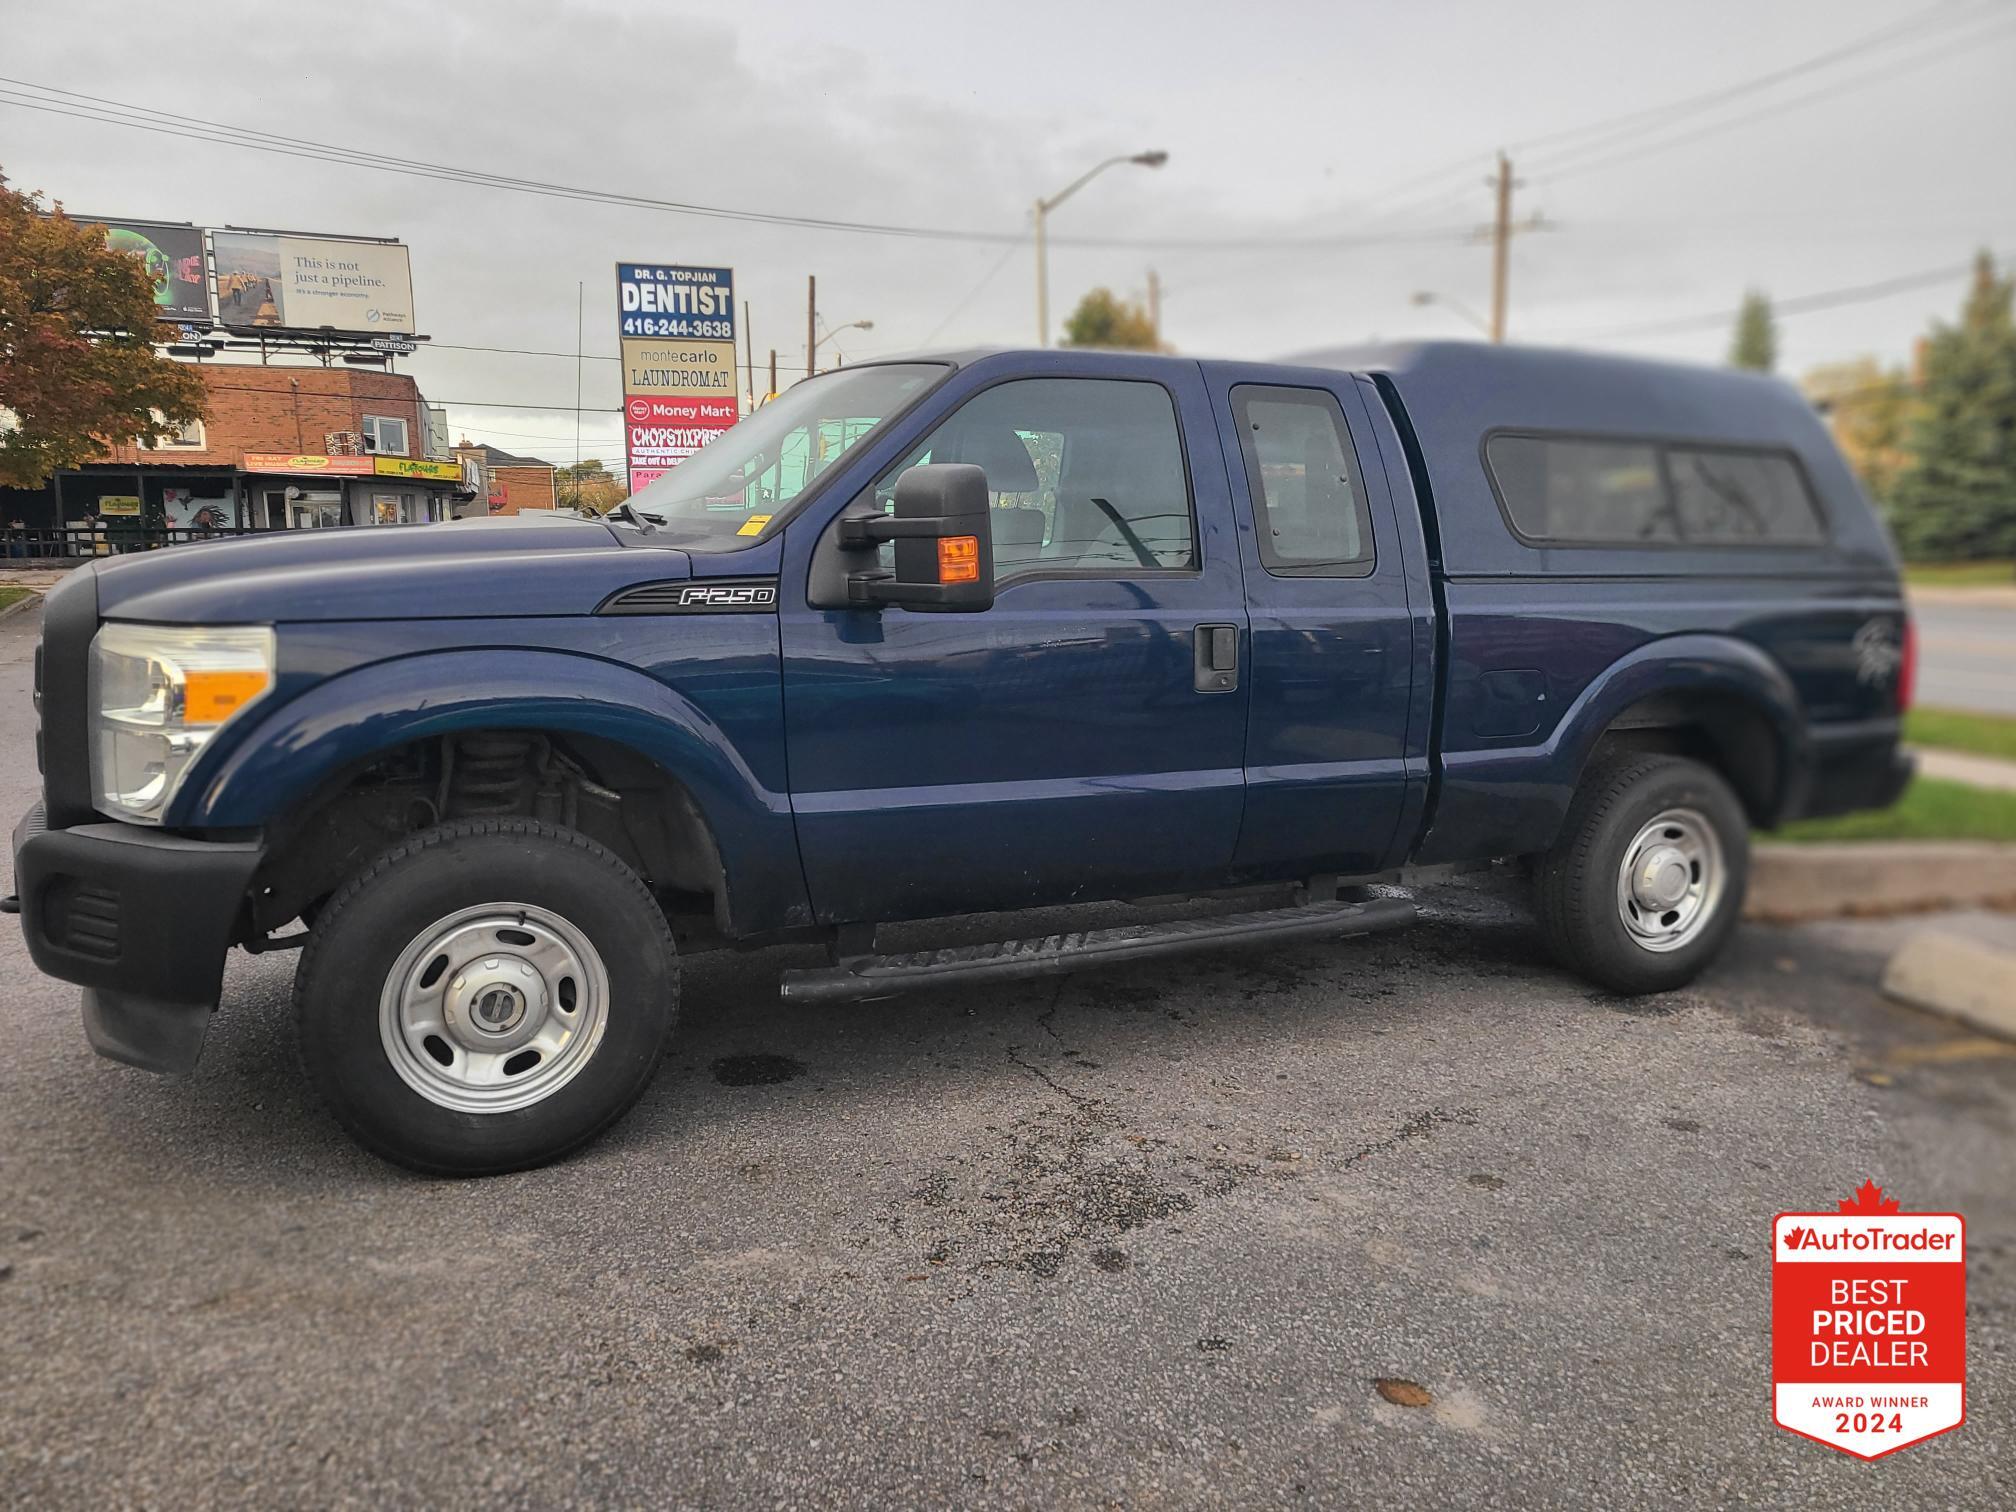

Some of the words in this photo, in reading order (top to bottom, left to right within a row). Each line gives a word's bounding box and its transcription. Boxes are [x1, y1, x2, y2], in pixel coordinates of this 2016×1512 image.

[294, 256, 322, 269] This
[325, 258, 336, 270] is
[339, 261, 360, 272] not
[294, 271, 319, 284] just
[321, 275, 329, 284] a
[332, 274, 386, 287] pipeline.
[634, 269, 654, 280] DR.
[656, 271, 668, 280] G.
[670, 271, 717, 283] TOPJIAN
[312, 289, 338, 298] stronger
[621, 282, 730, 316] DENTIST
[624, 318, 732, 337] 416-244-3638
[375, 341, 415, 351] PATTISON
[640, 349, 718, 364] montecarlo
[631, 368, 729, 388] LAUNDROMAT
[653, 404, 698, 420] Money
[648, 456, 660, 466] OUT
[678, 588, 776, 605] F-250
